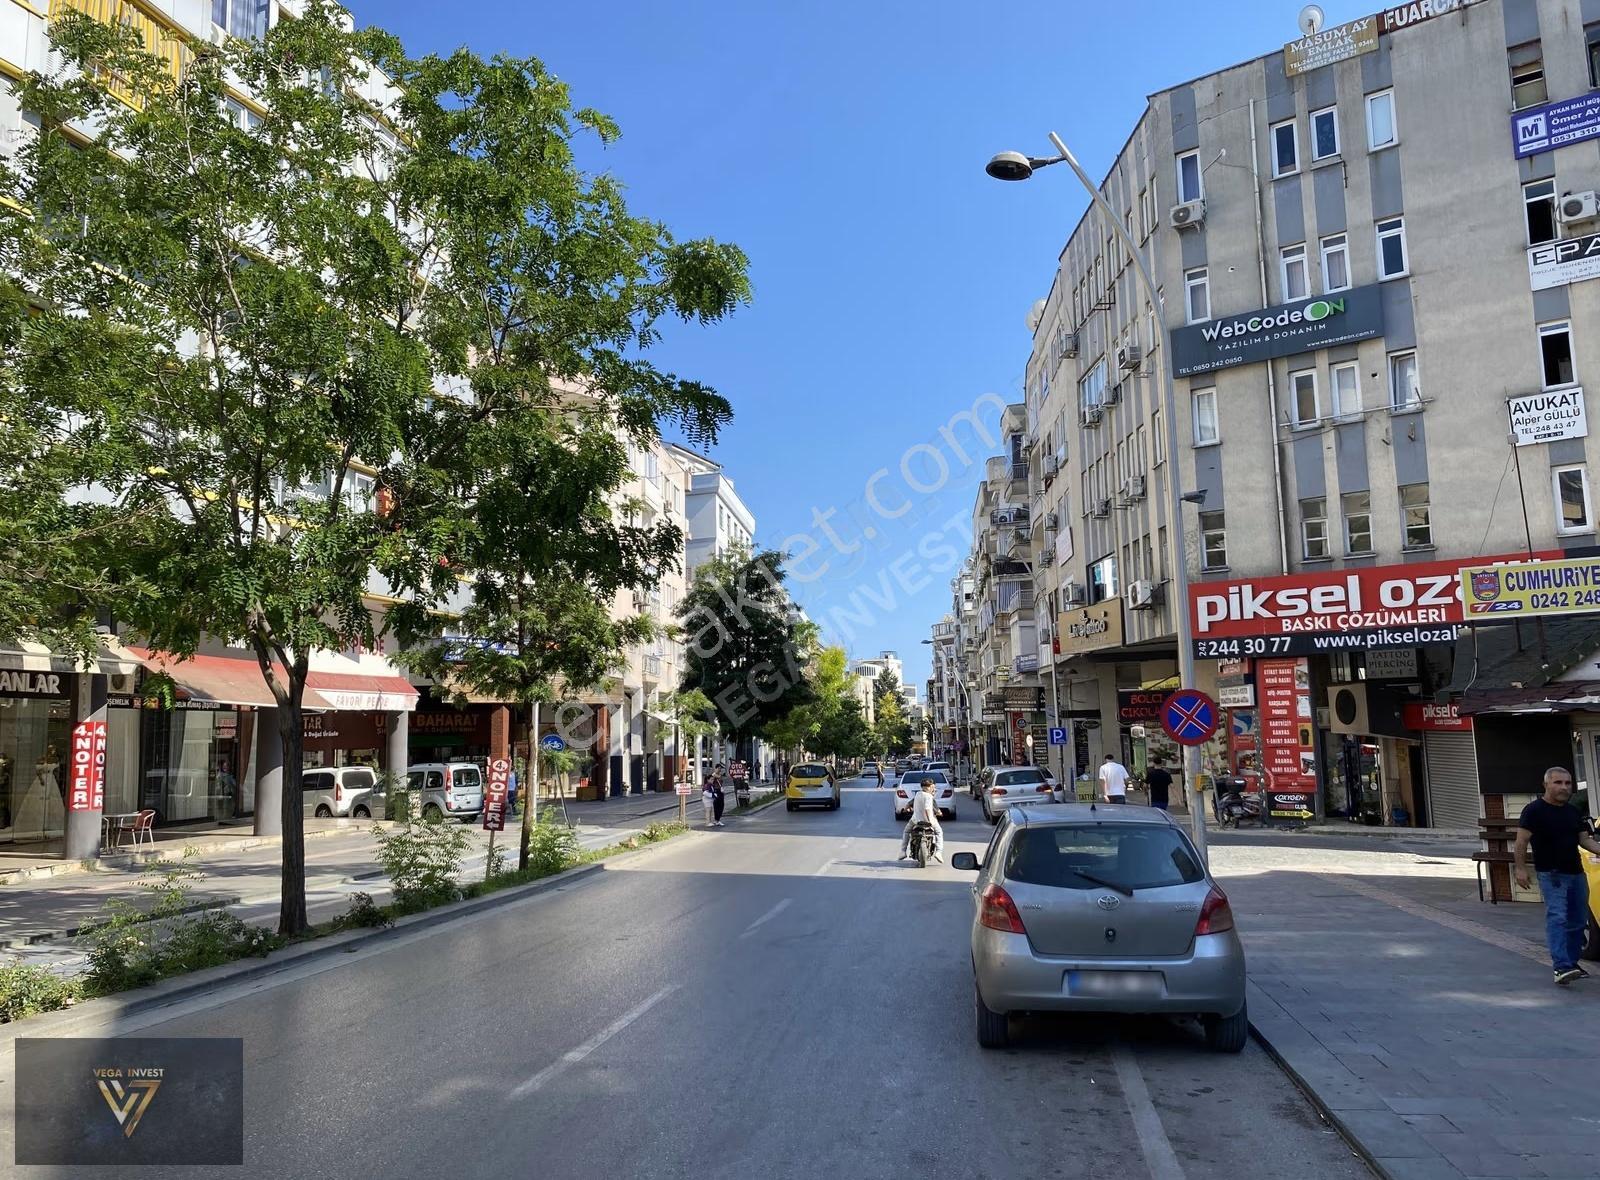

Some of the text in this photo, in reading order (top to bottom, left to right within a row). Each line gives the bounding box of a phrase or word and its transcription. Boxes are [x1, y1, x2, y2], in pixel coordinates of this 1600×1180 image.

[1290, 18, 1370, 53] MASUM AY
[1308, 35, 1354, 56] EMLAK
[1549, 106, 1570, 116] AYKAN
[1551, 113, 1583, 125] Ömer
[1553, 126, 1598, 143] 0531 310
[1217, 337, 1262, 351] YAZILIM
[1193, 363, 1211, 371] 0850
[1211, 359, 1224, 368] 242
[1224, 356, 1243, 365] 0850
[1512, 391, 1580, 416] AVUKAT
[1514, 405, 1581, 427] Alper GÜLLÜ
[1553, 422, 1564, 430] 43
[1566, 420, 1577, 429] 47
[1197, 575, 1362, 633] piksel
[1530, 591, 1570, 609] 0242
[1281, 604, 1447, 632] BASKI ÇÖZÜMLERİ
[1208, 640, 1240, 656] 244
[1244, 638, 1266, 654] 30
[1270, 636, 1292, 652] 77
[1372, 650, 1410, 660] TATTOO
[416, 714, 480, 727] BAHARAT
[1422, 703, 1451, 721] piksel
[1053, 729, 1064, 744] P
[74, 724, 93, 803] 4. NOTER
[94, 724, 107, 807] 4. NOTER
[486, 761, 507, 822] 4. NOTER
